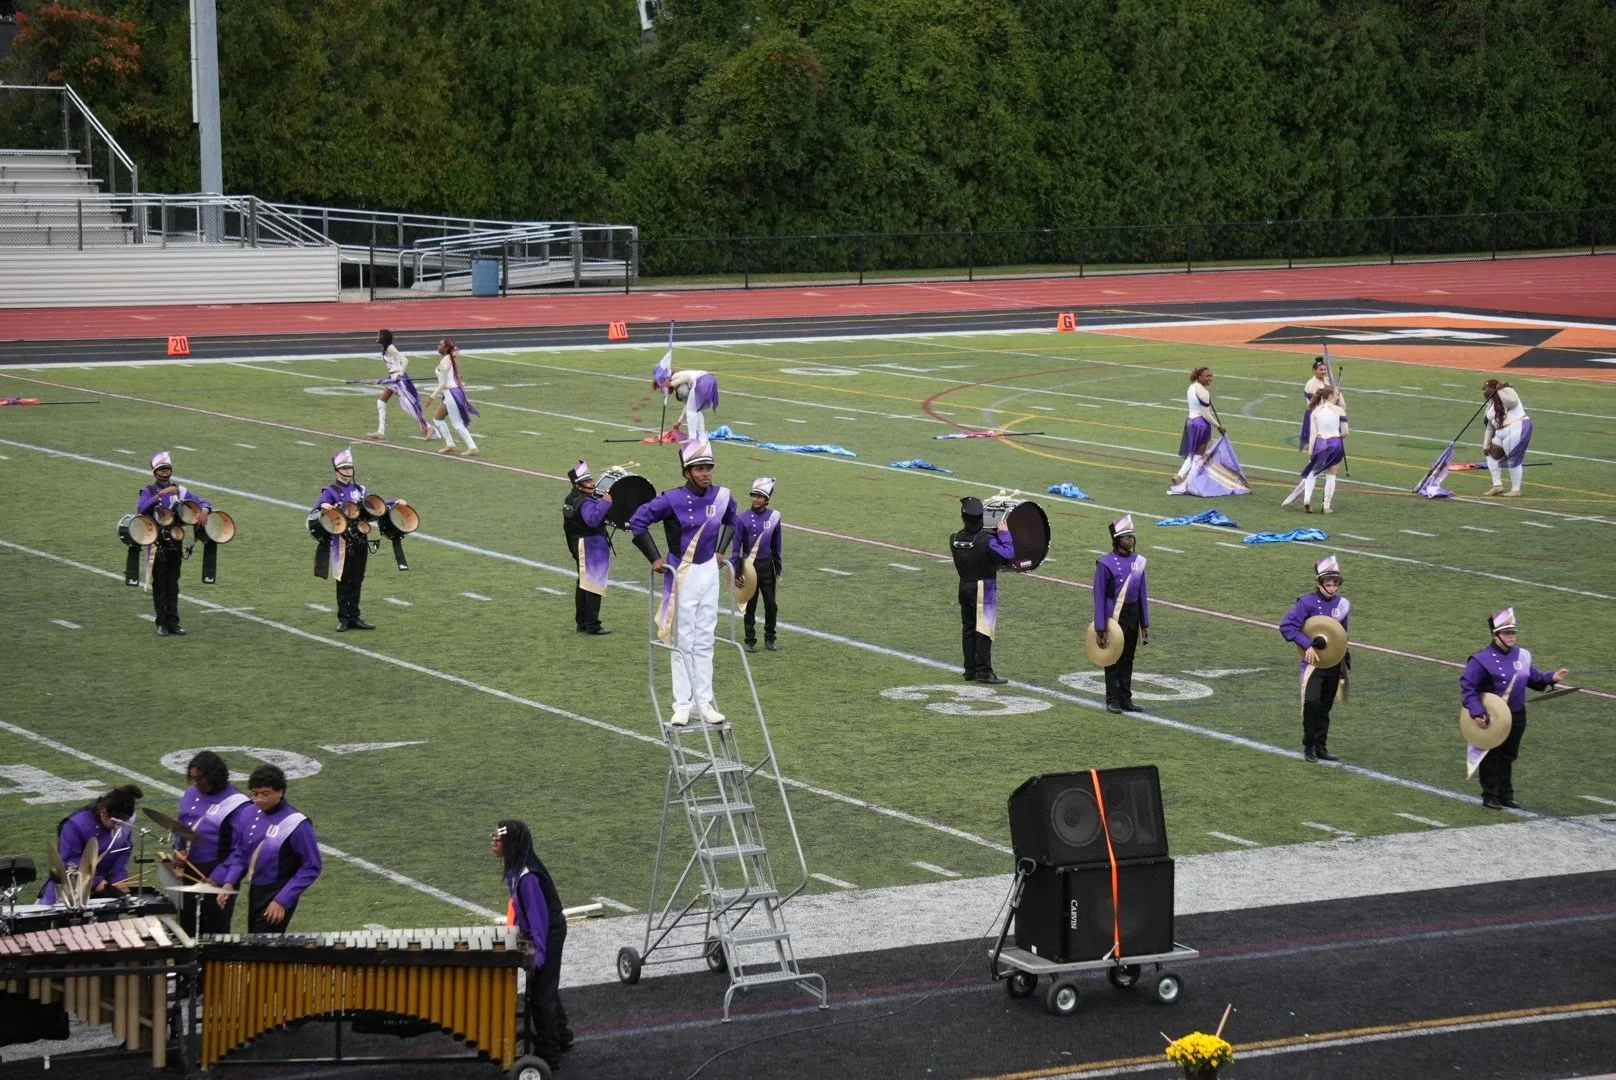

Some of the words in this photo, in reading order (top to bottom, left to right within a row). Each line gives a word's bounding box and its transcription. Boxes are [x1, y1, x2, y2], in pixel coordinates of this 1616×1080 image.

[1063, 314, 1073, 329] G
[613, 323, 626, 337] 10
[171, 338, 187, 352] 20
[1070, 899, 1078, 930] CARVIN
